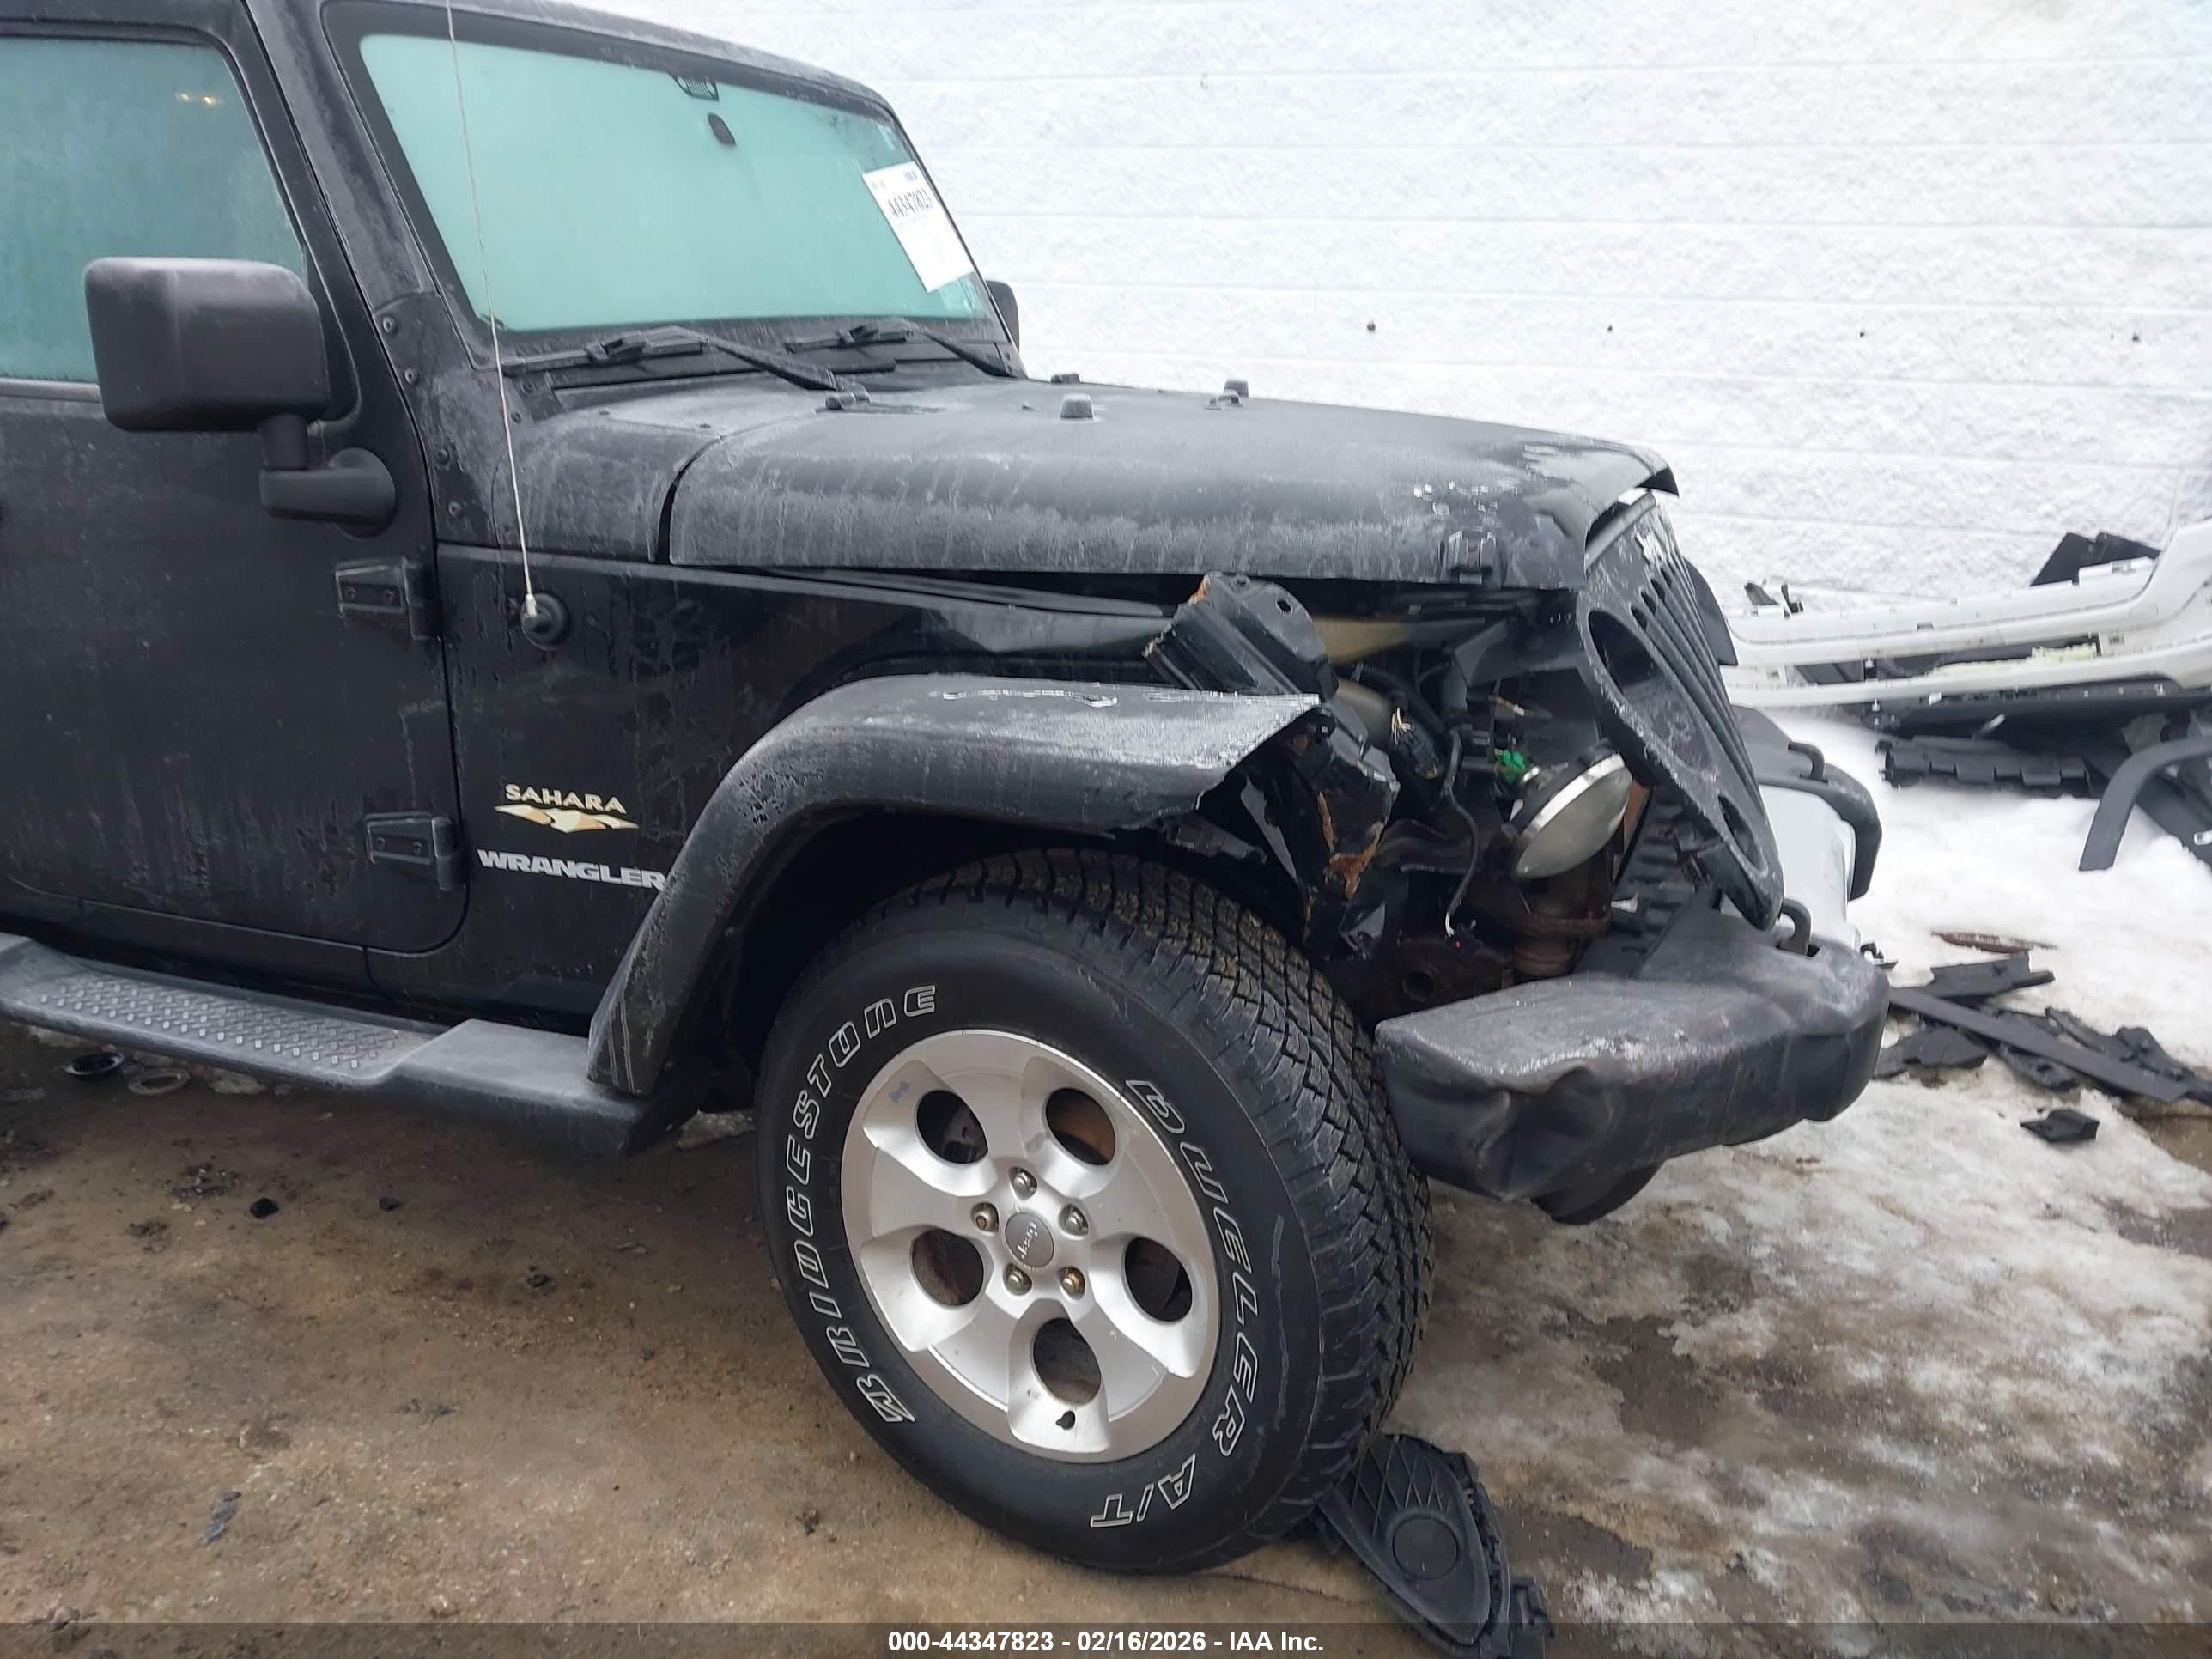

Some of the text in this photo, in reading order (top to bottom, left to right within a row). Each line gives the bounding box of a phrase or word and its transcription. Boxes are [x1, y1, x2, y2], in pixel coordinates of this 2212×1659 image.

[887, 186, 933, 219] 44347823
[505, 783, 627, 815] SAHARA
[477, 848, 666, 891] WRANGLER
[785, 985, 936, 1423] BRIDGESTONE
[1090, 1079, 1259, 1528] DUELER A/T
